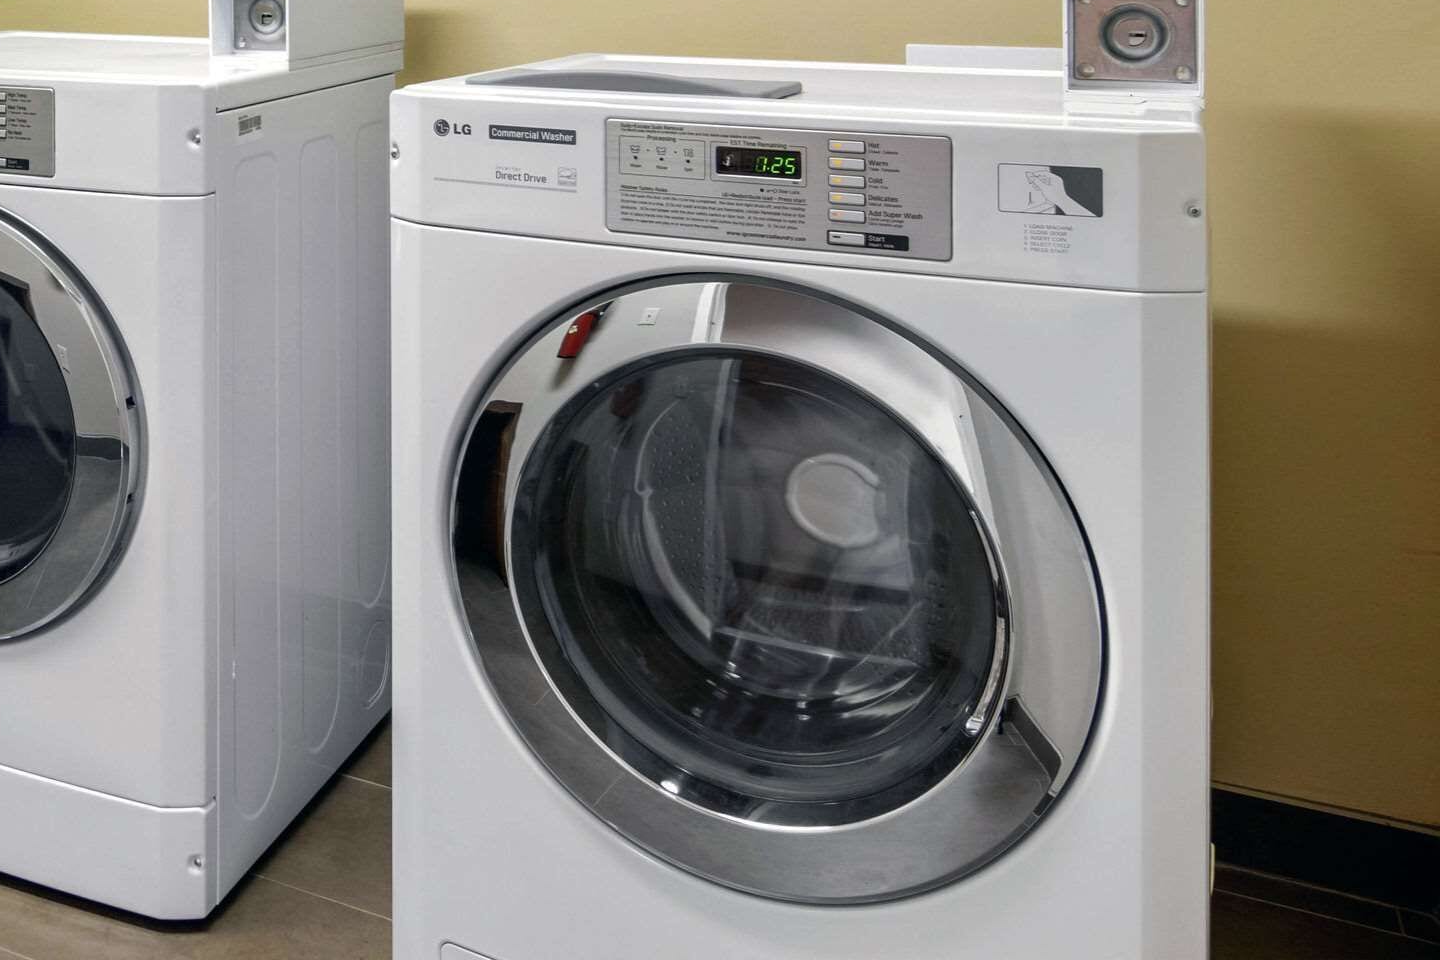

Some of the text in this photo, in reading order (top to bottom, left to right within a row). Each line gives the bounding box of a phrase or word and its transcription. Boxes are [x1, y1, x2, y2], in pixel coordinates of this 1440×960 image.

[453, 123, 472, 135] LG
[491, 127, 574, 142] Commercial Washer
[758, 142, 787, 150] Remaining
[496, 170, 547, 184] Direct Drive
[868, 194, 899, 202] Delicates
